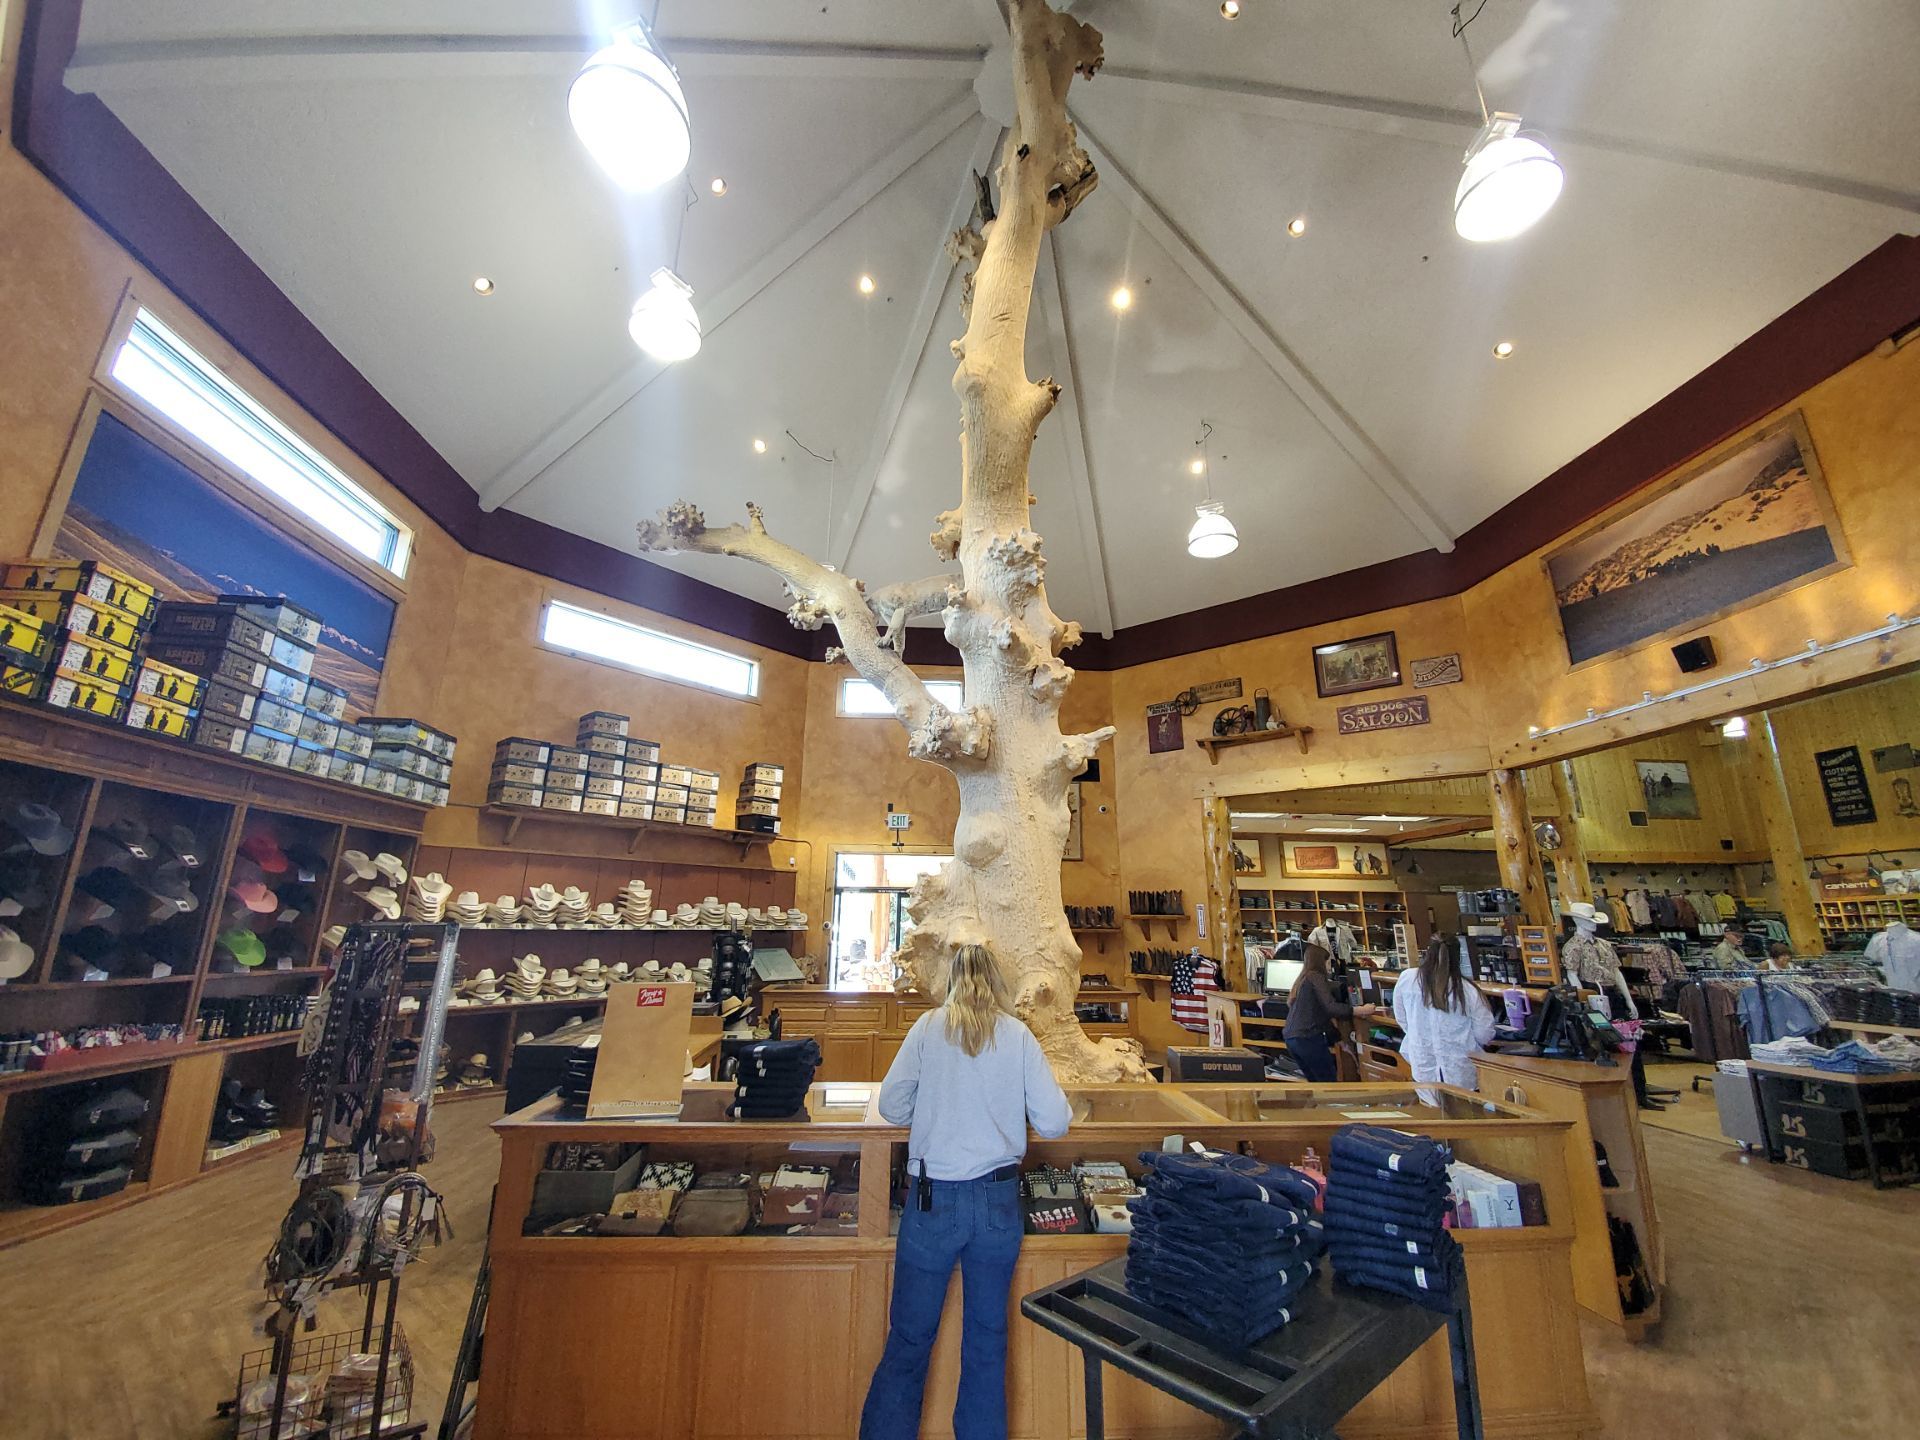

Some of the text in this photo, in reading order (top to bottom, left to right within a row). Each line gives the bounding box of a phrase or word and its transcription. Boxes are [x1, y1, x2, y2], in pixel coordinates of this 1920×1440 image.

[1357, 704, 1378, 715] RED
[1380, 702, 1404, 712] DOG
[1343, 706, 1423, 730] SALOON
[1824, 764, 1857, 776] CLOTHING
[892, 815, 907, 827] EXIT
[1825, 881, 1868, 890] carhartt
[1202, 1062, 1243, 1072] BOOT BARN
[1029, 1206, 1076, 1223] NASH
[1033, 1216, 1079, 1232] Vegas
